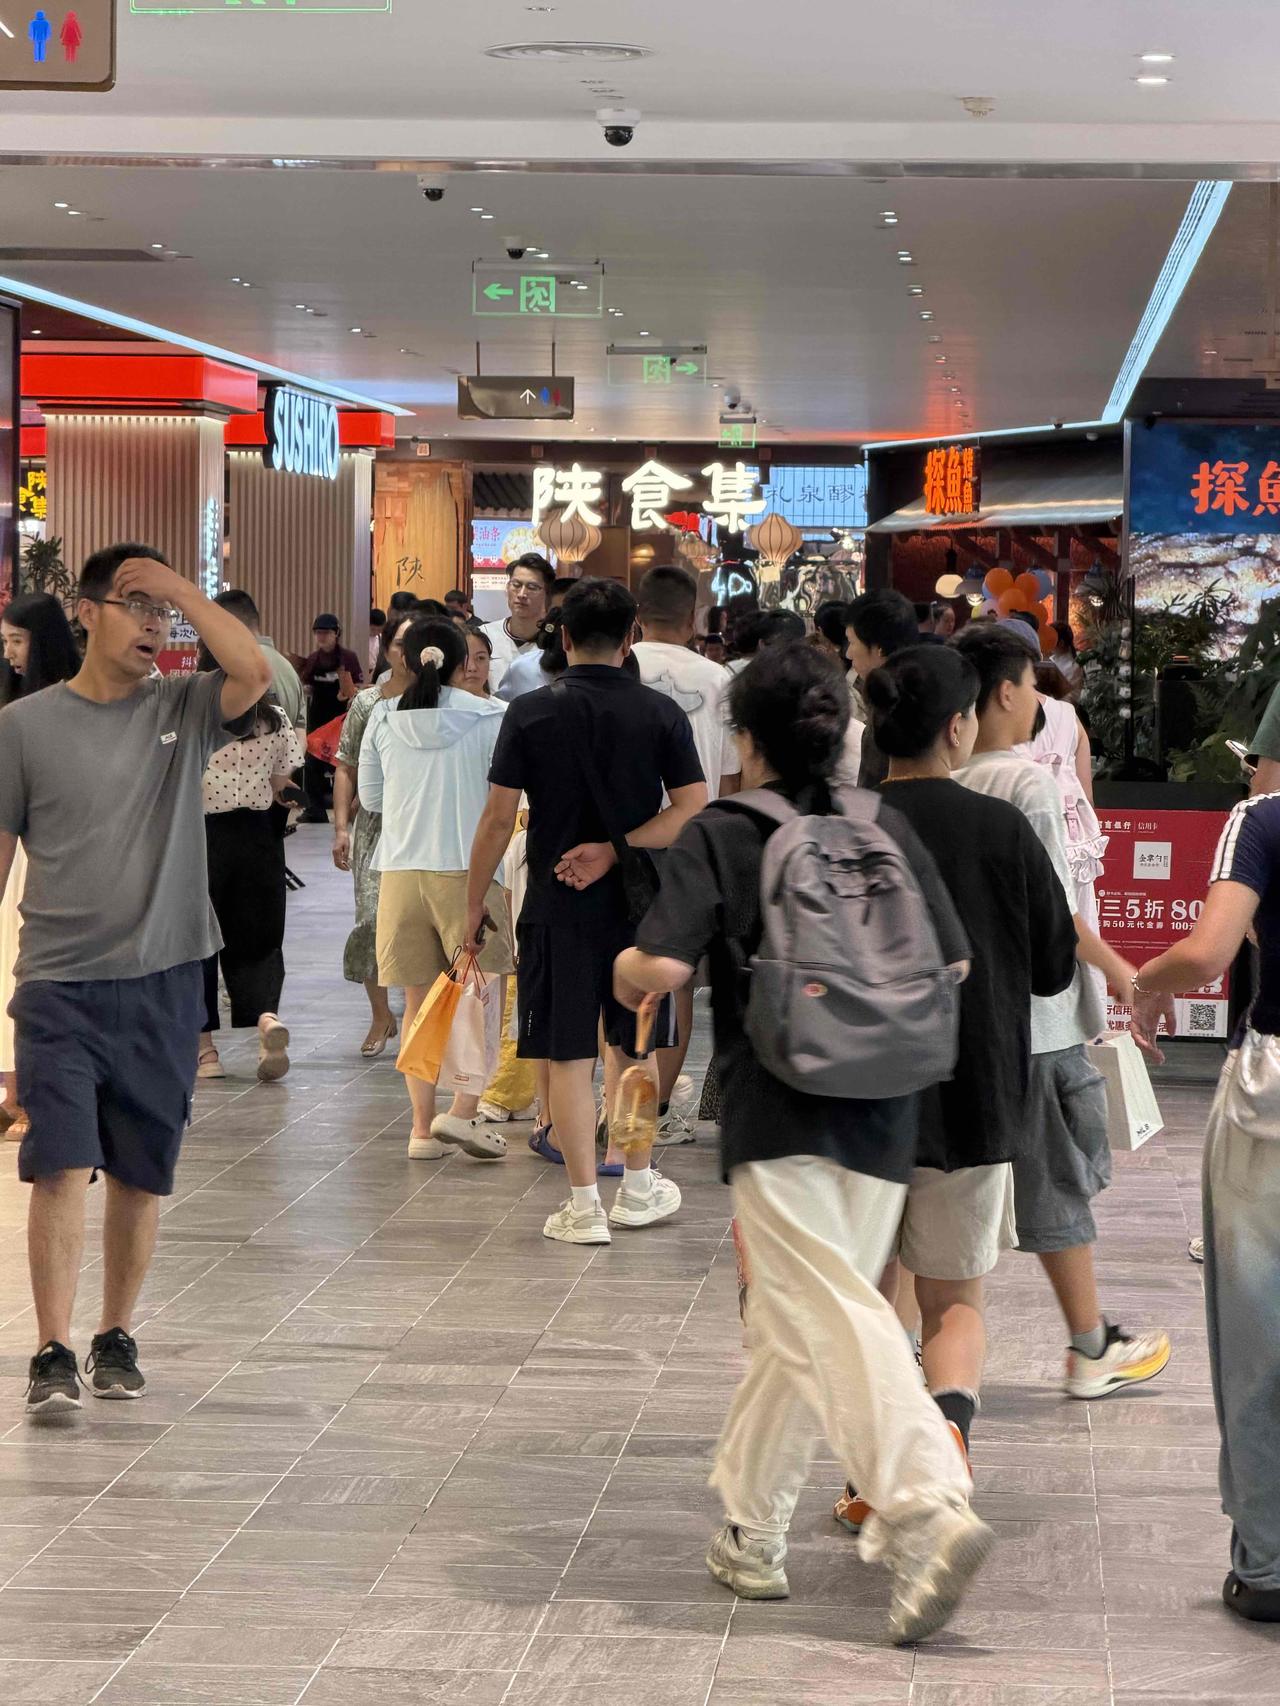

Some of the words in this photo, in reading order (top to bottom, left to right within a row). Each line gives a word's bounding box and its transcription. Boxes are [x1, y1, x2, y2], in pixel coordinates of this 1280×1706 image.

[272, 390, 340, 480] SUSHIRO
[531, 459, 768, 534] 陕食集
